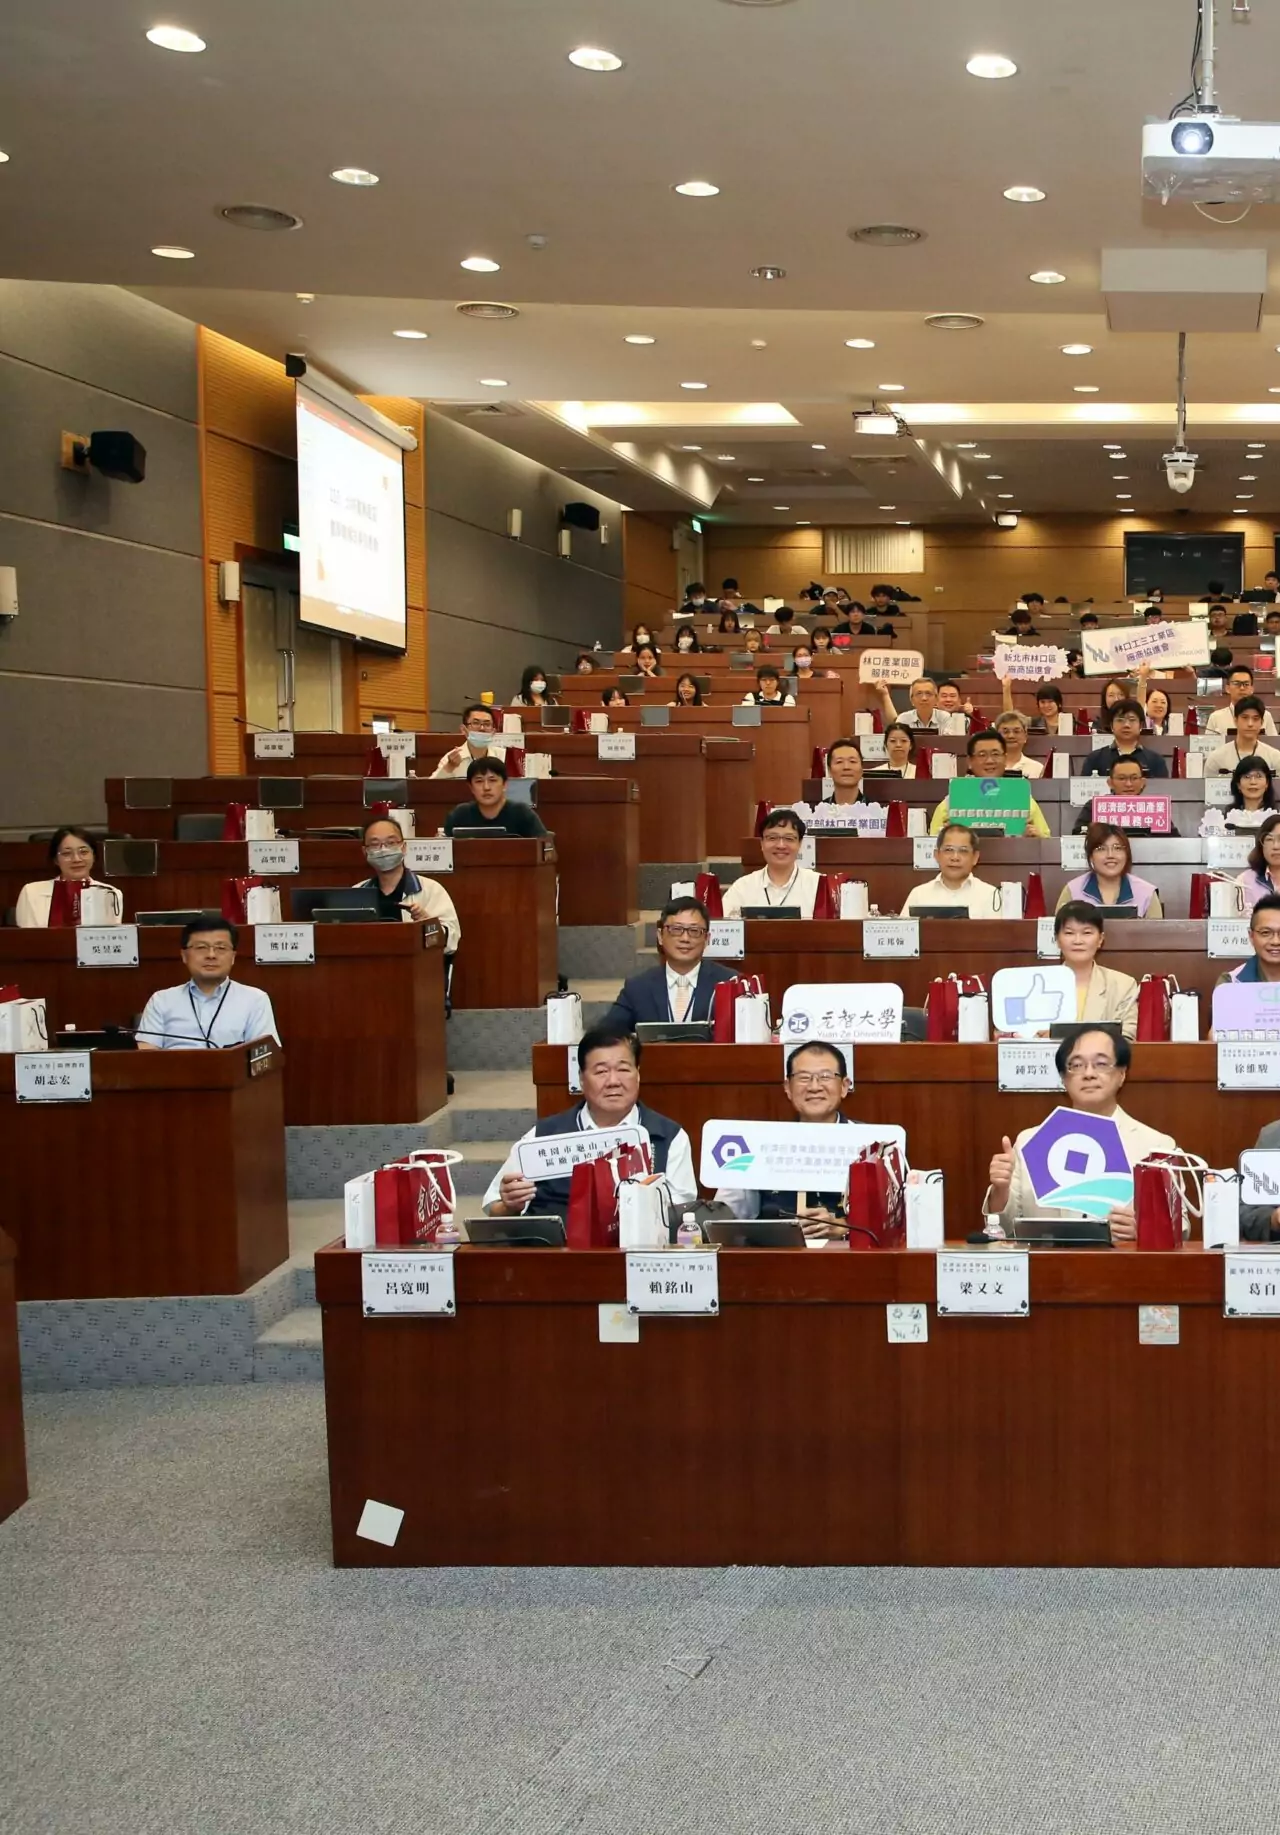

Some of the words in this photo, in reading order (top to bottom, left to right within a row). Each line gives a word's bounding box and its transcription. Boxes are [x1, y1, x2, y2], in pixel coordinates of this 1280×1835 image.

[863, 657, 920, 667] 林口產業園區
[1004, 653, 1057, 664] 新北市林口區
[816, 1008, 898, 1029] 元智大學
[839, 1030, 851, 1038] Ze
[853, 1031, 895, 1040] University
[649, 1280, 694, 1294] 賴銘山
[960, 1280, 1004, 1295] 梁又文
